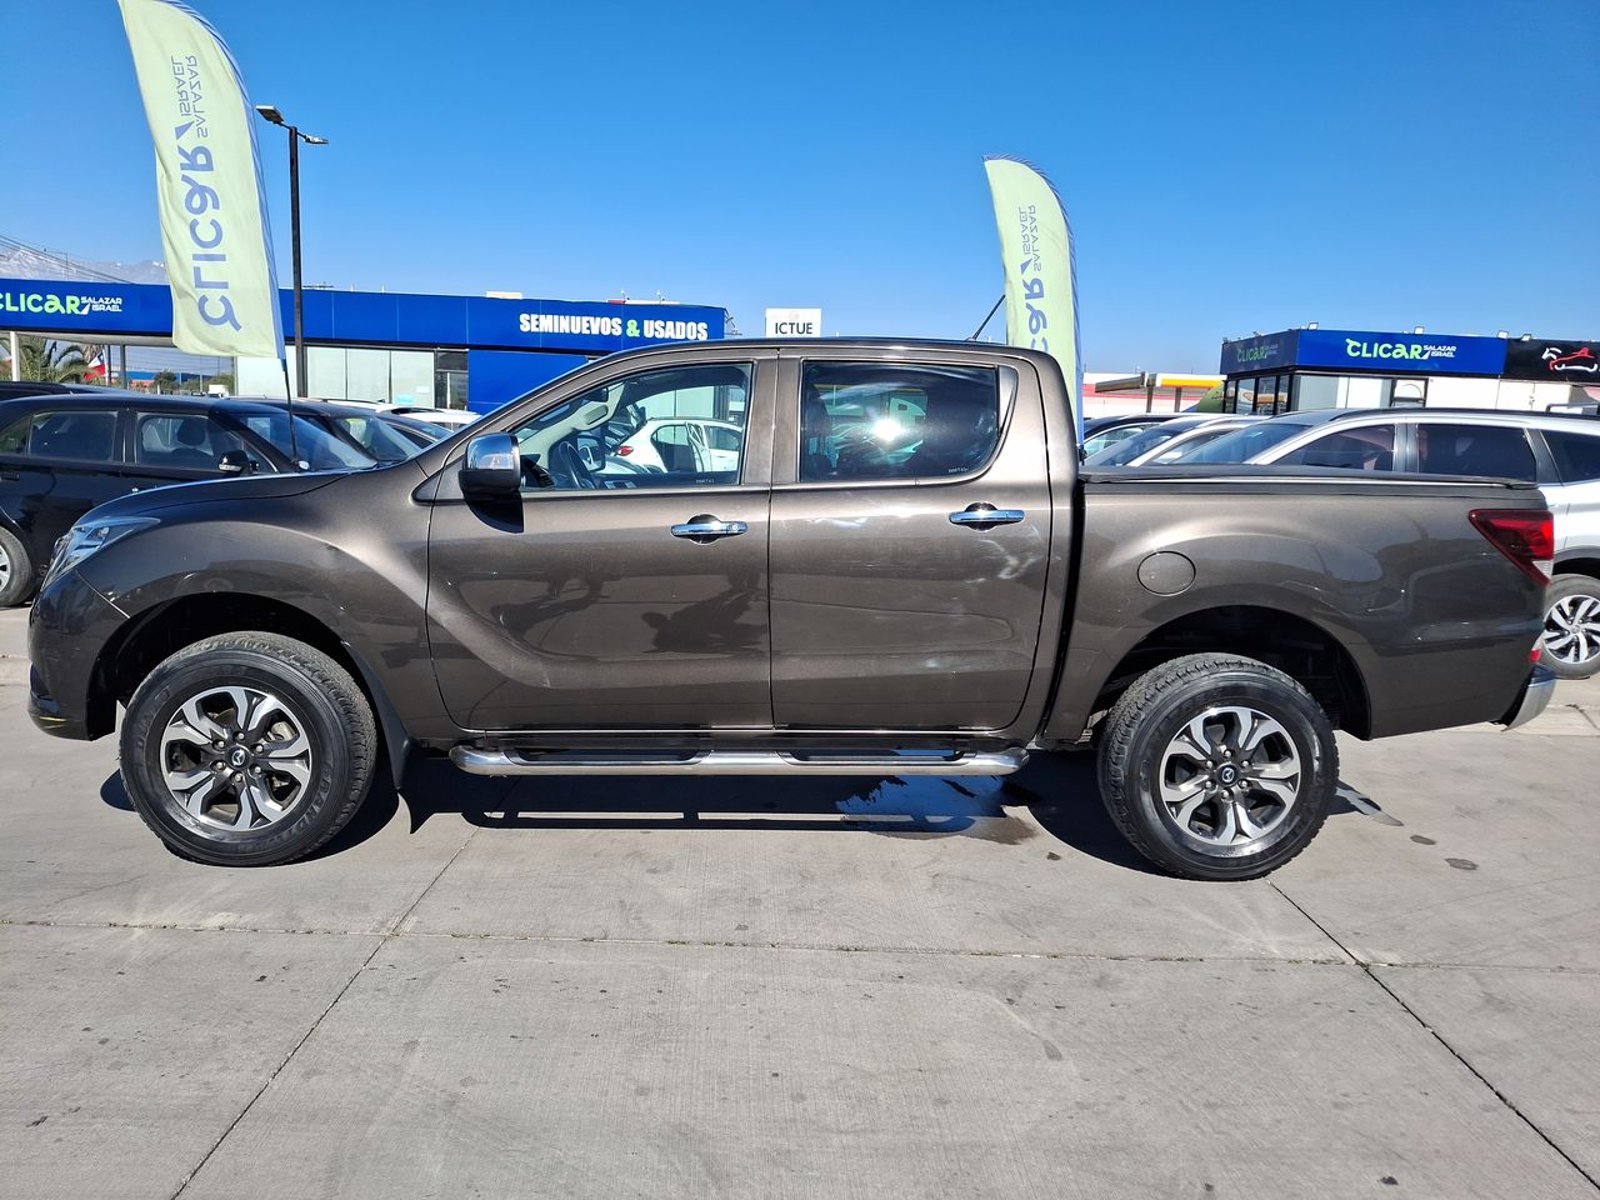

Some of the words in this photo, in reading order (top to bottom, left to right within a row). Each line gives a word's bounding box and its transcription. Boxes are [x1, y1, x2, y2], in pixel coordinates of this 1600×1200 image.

[81, 296, 123, 305] SALAZAR
[91, 304, 123, 312] ISRAEL
[519, 313, 622, 336] SEMINUEVOS
[626, 319, 640, 338] &
[643, 320, 708, 341] USADOS
[775, 322, 813, 335] ICTUE
[1430, 350, 1456, 358] ISRAEL
